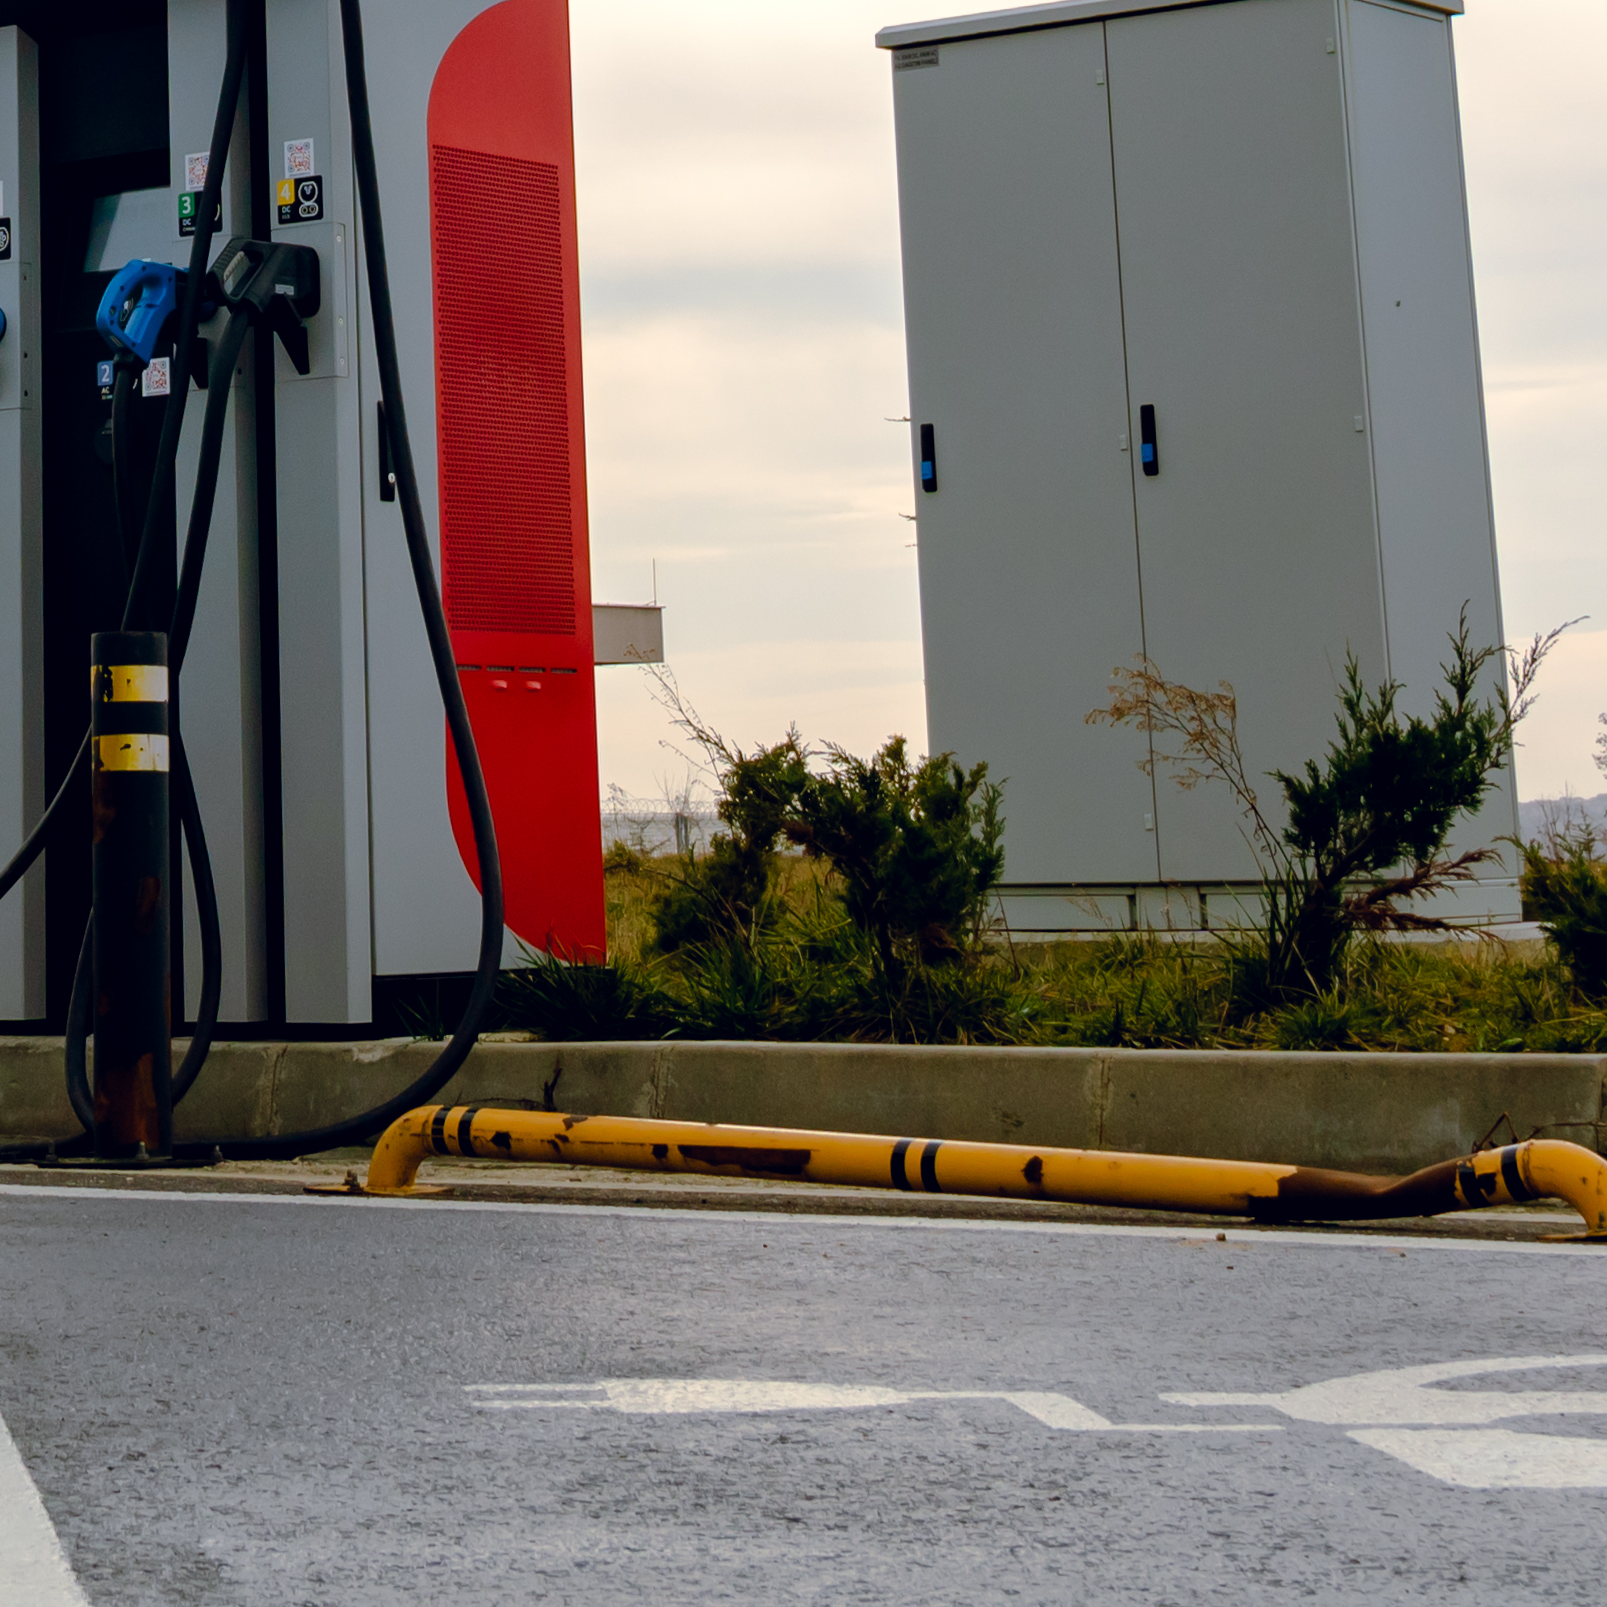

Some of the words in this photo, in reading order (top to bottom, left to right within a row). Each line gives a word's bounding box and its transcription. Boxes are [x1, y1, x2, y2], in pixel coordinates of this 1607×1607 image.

[280, 182, 291, 201] 4
[181, 196, 191, 214] 3
[101, 364, 110, 383] 2
